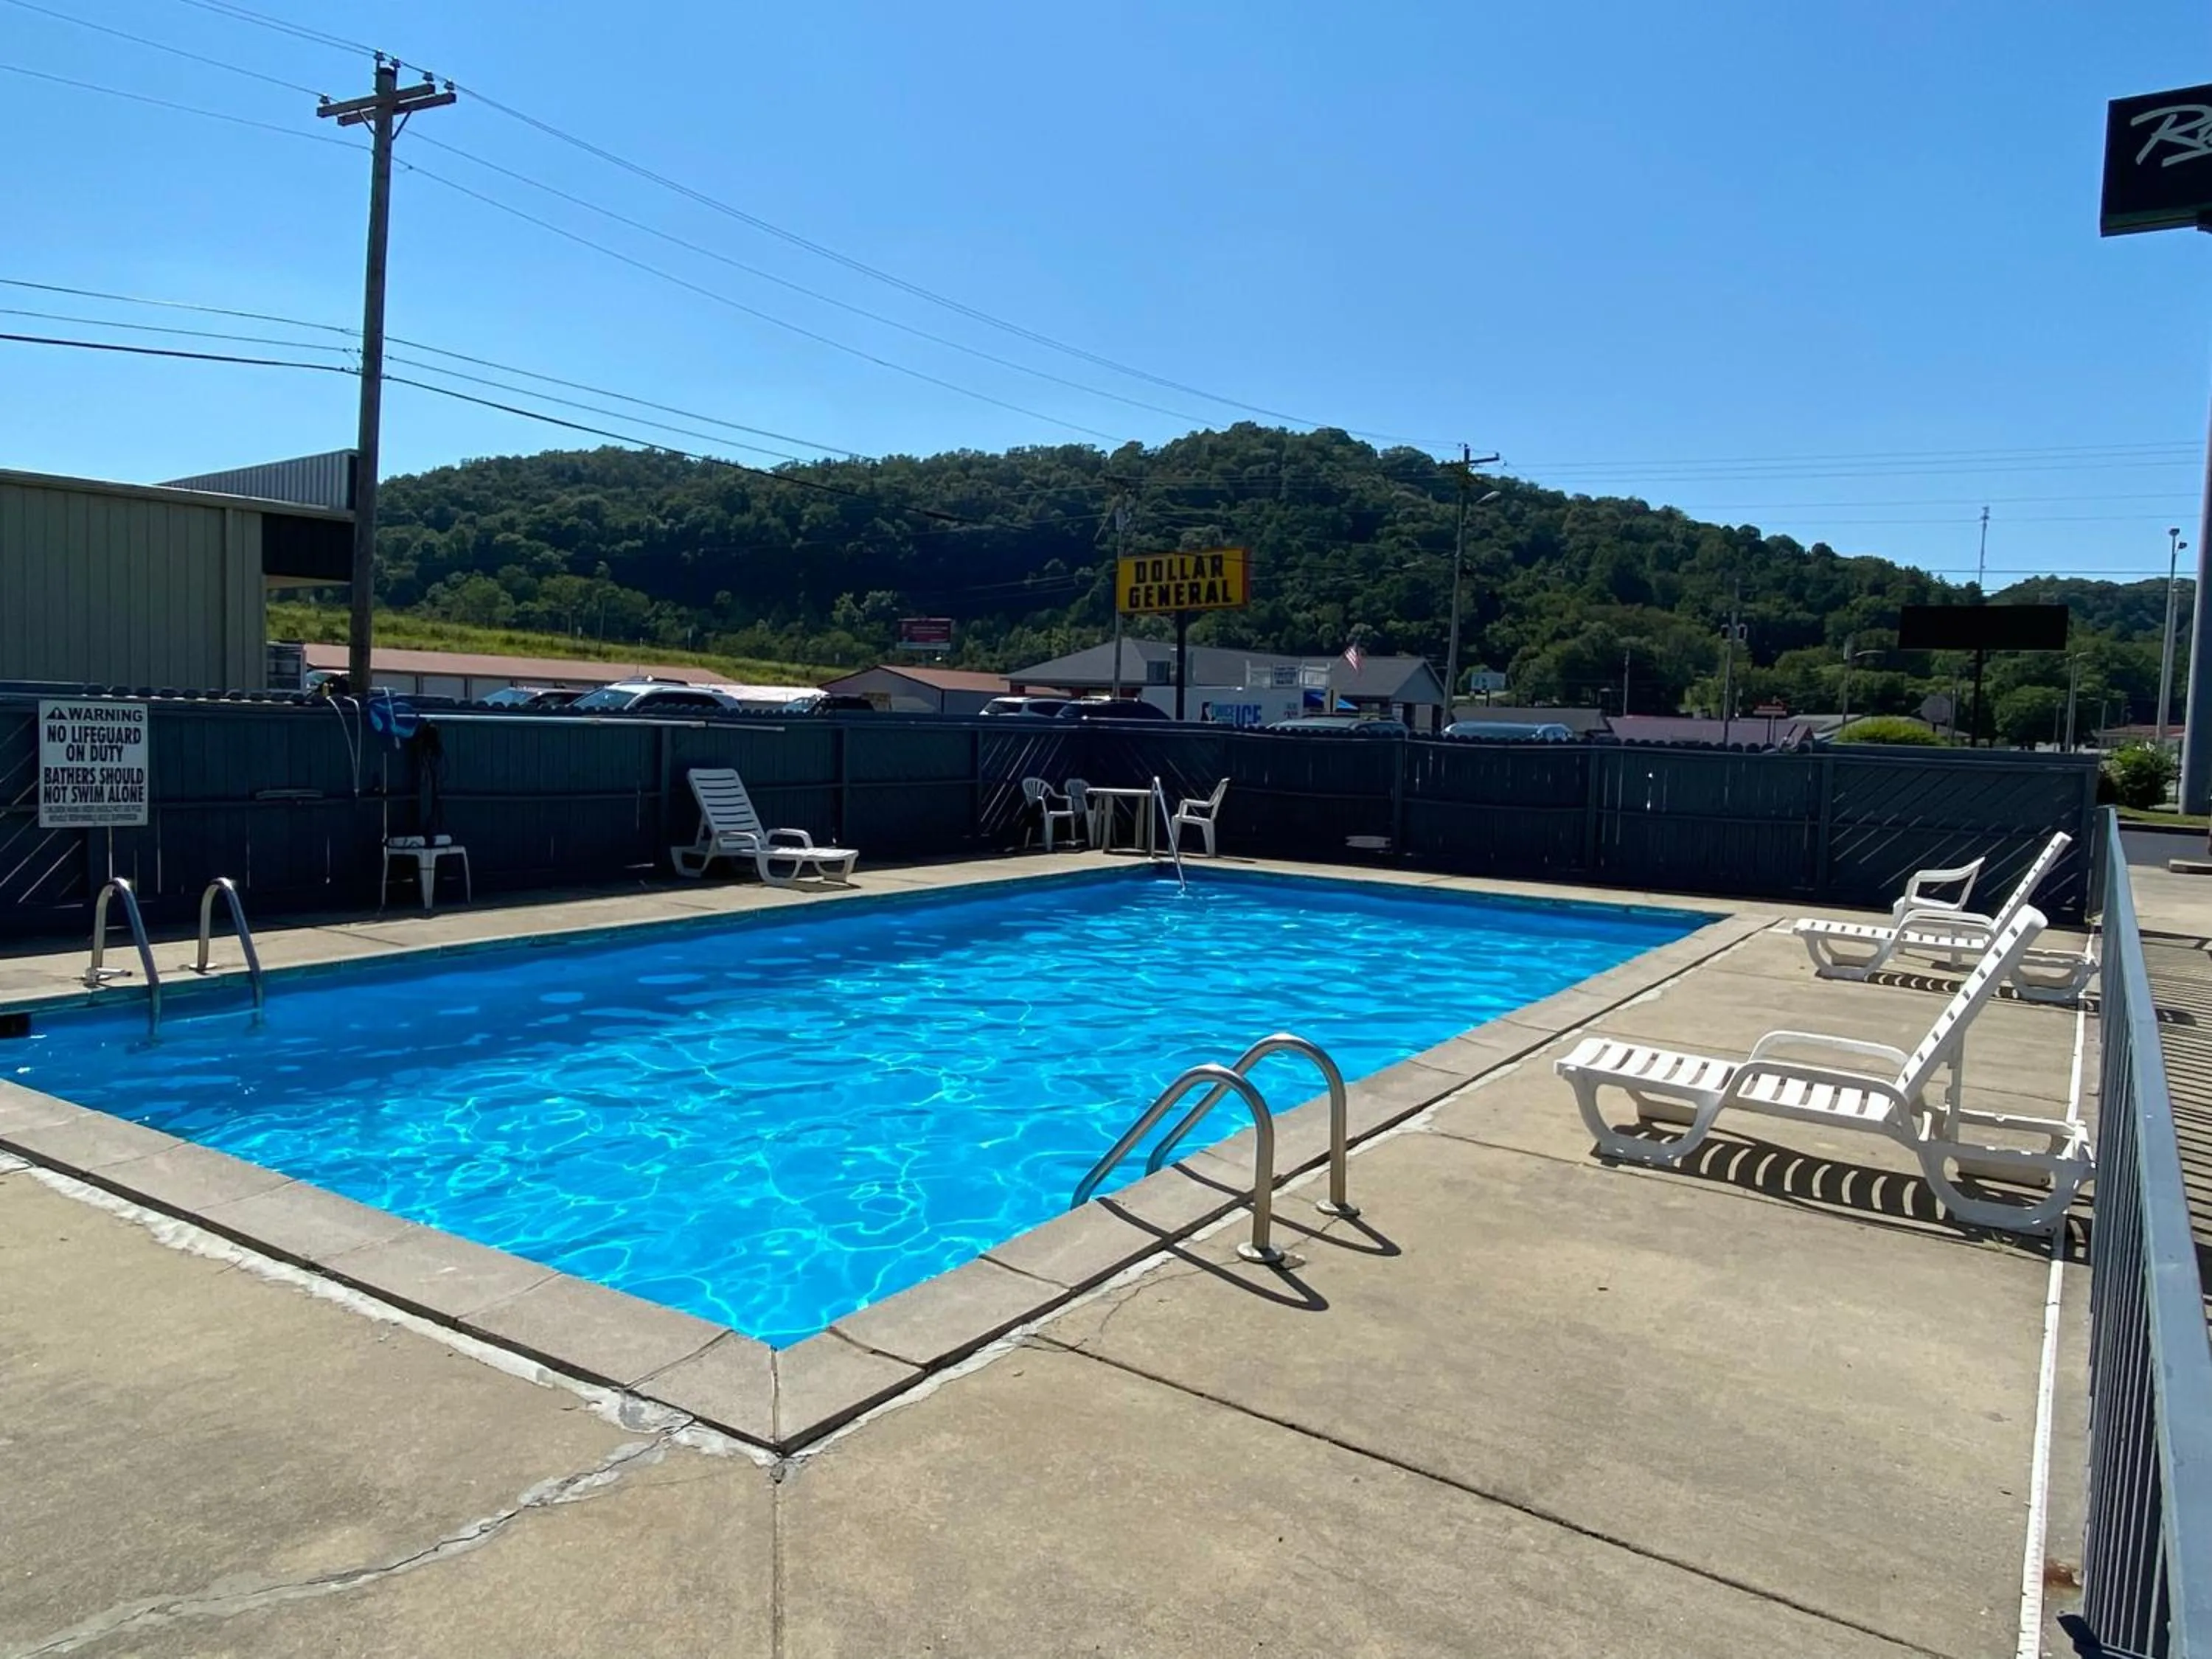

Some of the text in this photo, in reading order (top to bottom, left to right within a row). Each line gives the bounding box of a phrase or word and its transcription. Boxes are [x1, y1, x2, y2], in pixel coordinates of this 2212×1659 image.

[1135, 554, 1224, 582] DOLLAR
[1129, 580, 1232, 608] GENERAL
[68, 708, 142, 722] WARNING
[1235, 704, 1262, 725] ICE
[47, 725, 142, 744] NO LIFEGUARD
[66, 744, 123, 762] ON DUTY
[44, 767, 144, 785] BATHERS SHOULD
[44, 786, 144, 803] NOT SWIM ALONE
